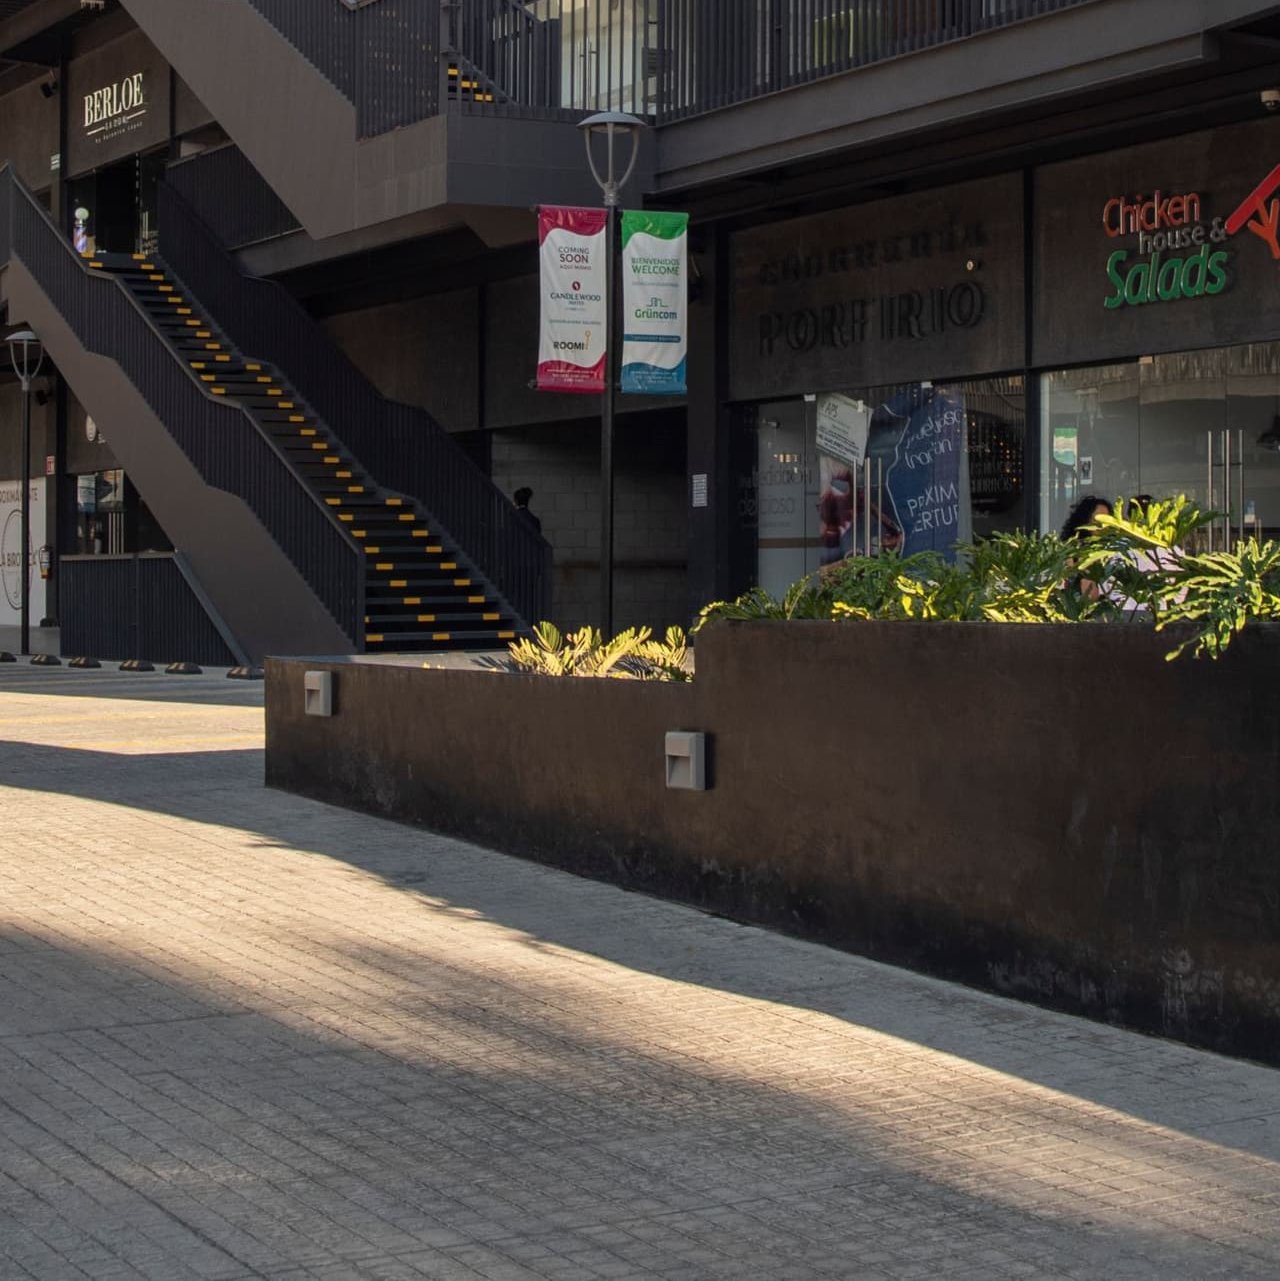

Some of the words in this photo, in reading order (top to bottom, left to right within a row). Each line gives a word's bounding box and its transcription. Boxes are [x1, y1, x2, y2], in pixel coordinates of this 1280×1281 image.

[83, 72, 144, 127] BERLOE
[1103, 189, 1200, 237] Chicken
[1139, 221, 1205, 254] house
[1210, 216, 1227, 243] &
[558, 246, 590, 255] COMING
[560, 254, 589, 263] SOON
[632, 257, 680, 266] BIENVENIDOS
[632, 265, 680, 276] WELCOME
[1103, 243, 1227, 309] Salads
[550, 292, 601, 302] CANDLEWOOD
[634, 309, 677, 319] Grüncom
[759, 280, 986, 357] PORFIRIO
